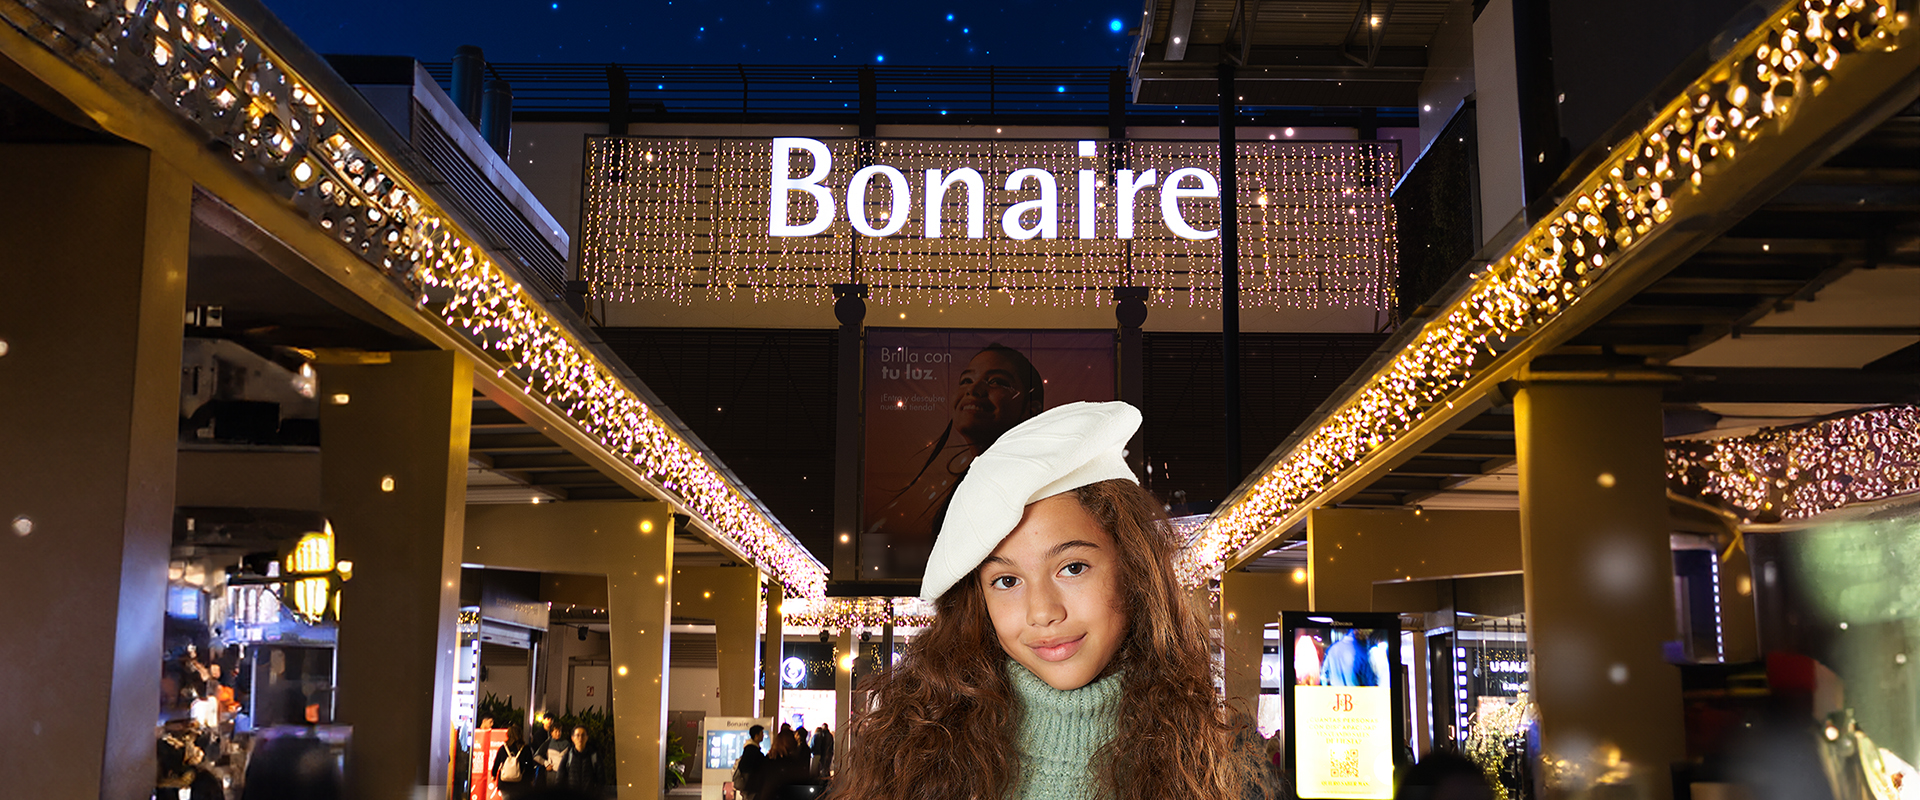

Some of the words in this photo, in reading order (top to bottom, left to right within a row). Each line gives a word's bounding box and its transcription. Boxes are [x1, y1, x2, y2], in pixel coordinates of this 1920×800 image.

[769, 137, 1220, 240] Bonaire
[881, 346, 919, 362] Brilla
[924, 352, 952, 363] con
[882, 365, 900, 380] tu
[906, 363, 937, 380] luz.
[904, 396, 909, 404] y
[911, 393, 946, 403] descubre
[909, 402, 936, 411] tienda!
